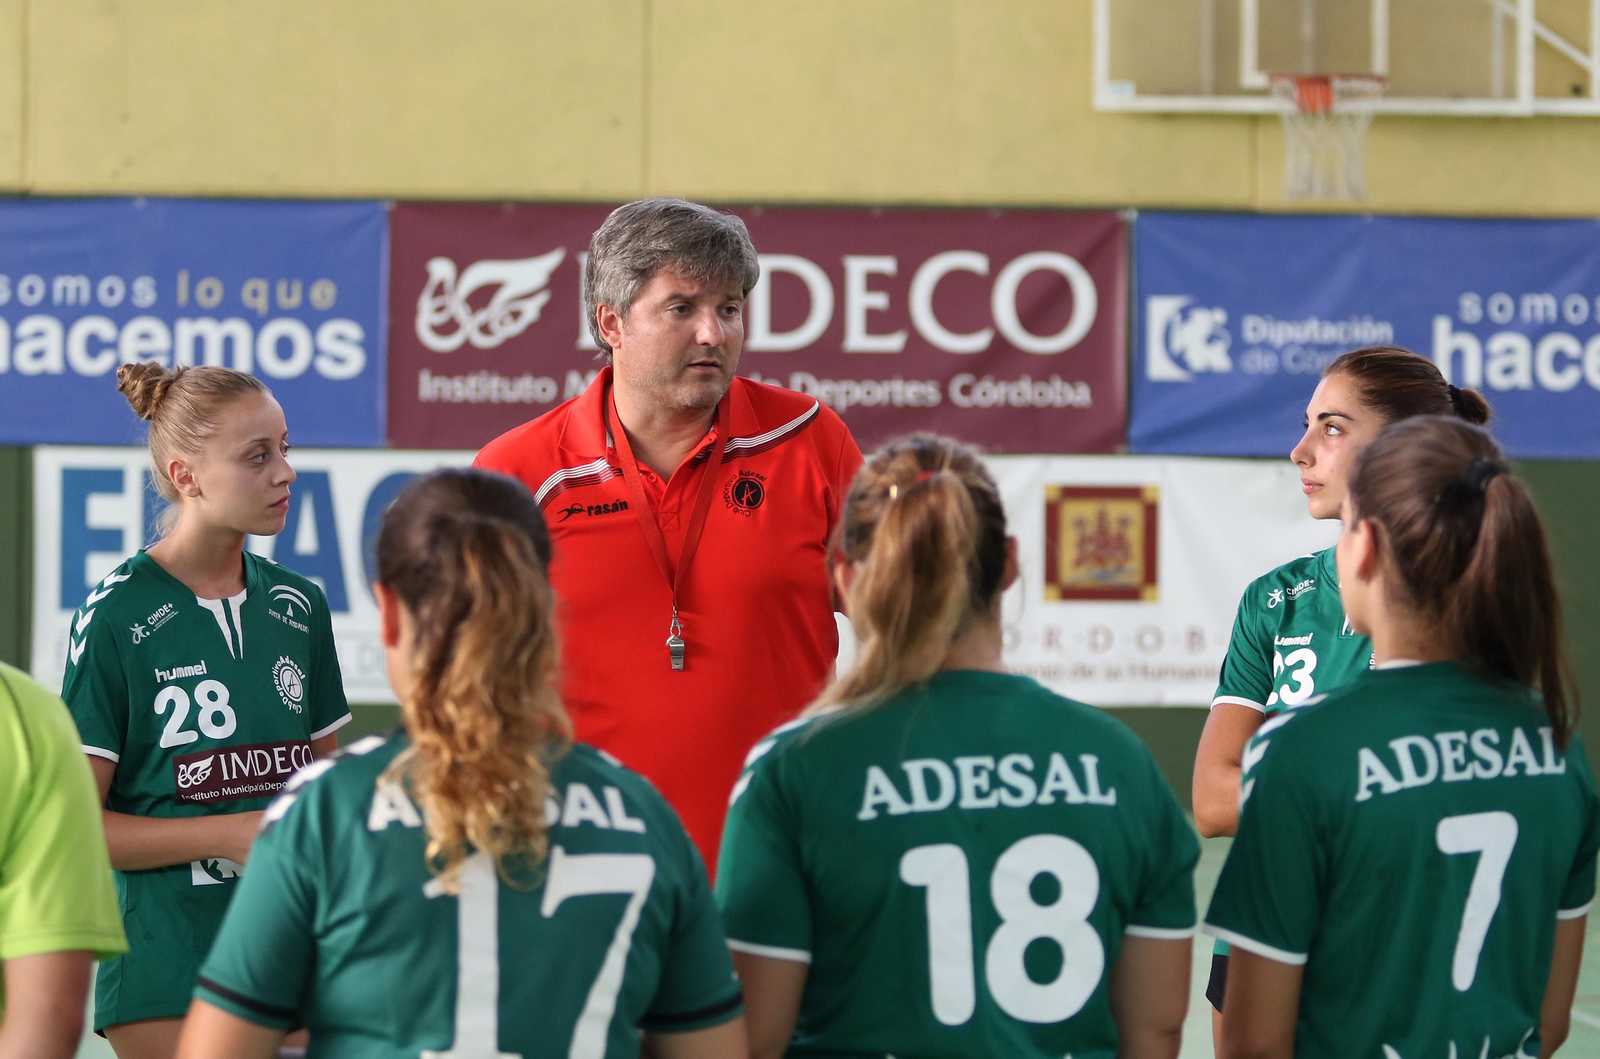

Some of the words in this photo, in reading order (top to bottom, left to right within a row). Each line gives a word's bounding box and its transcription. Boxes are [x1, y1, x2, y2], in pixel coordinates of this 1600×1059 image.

[177, 269, 224, 309] lo
[241, 277, 338, 317] que
[1458, 292, 1600, 325] somo
[0, 314, 366, 379] acemos
[418, 370, 557, 403] Instituto
[789, 371, 942, 412] Deportes
[949, 371, 1093, 409] Córdoba
[587, 498, 629, 517] rasán
[1274, 632, 1314, 647] ummel
[155, 660, 207, 683] hummel
[153, 679, 237, 749] 28
[218, 744, 315, 781] IMDECO
[857, 752, 1117, 821] ADESAL
[1355, 726, 1566, 801] ADESAL
[367, 782, 647, 832] AAL
[1435, 811, 1518, 992] 7
[420, 845, 656, 1059] 17
[899, 833, 1106, 1026] 18
